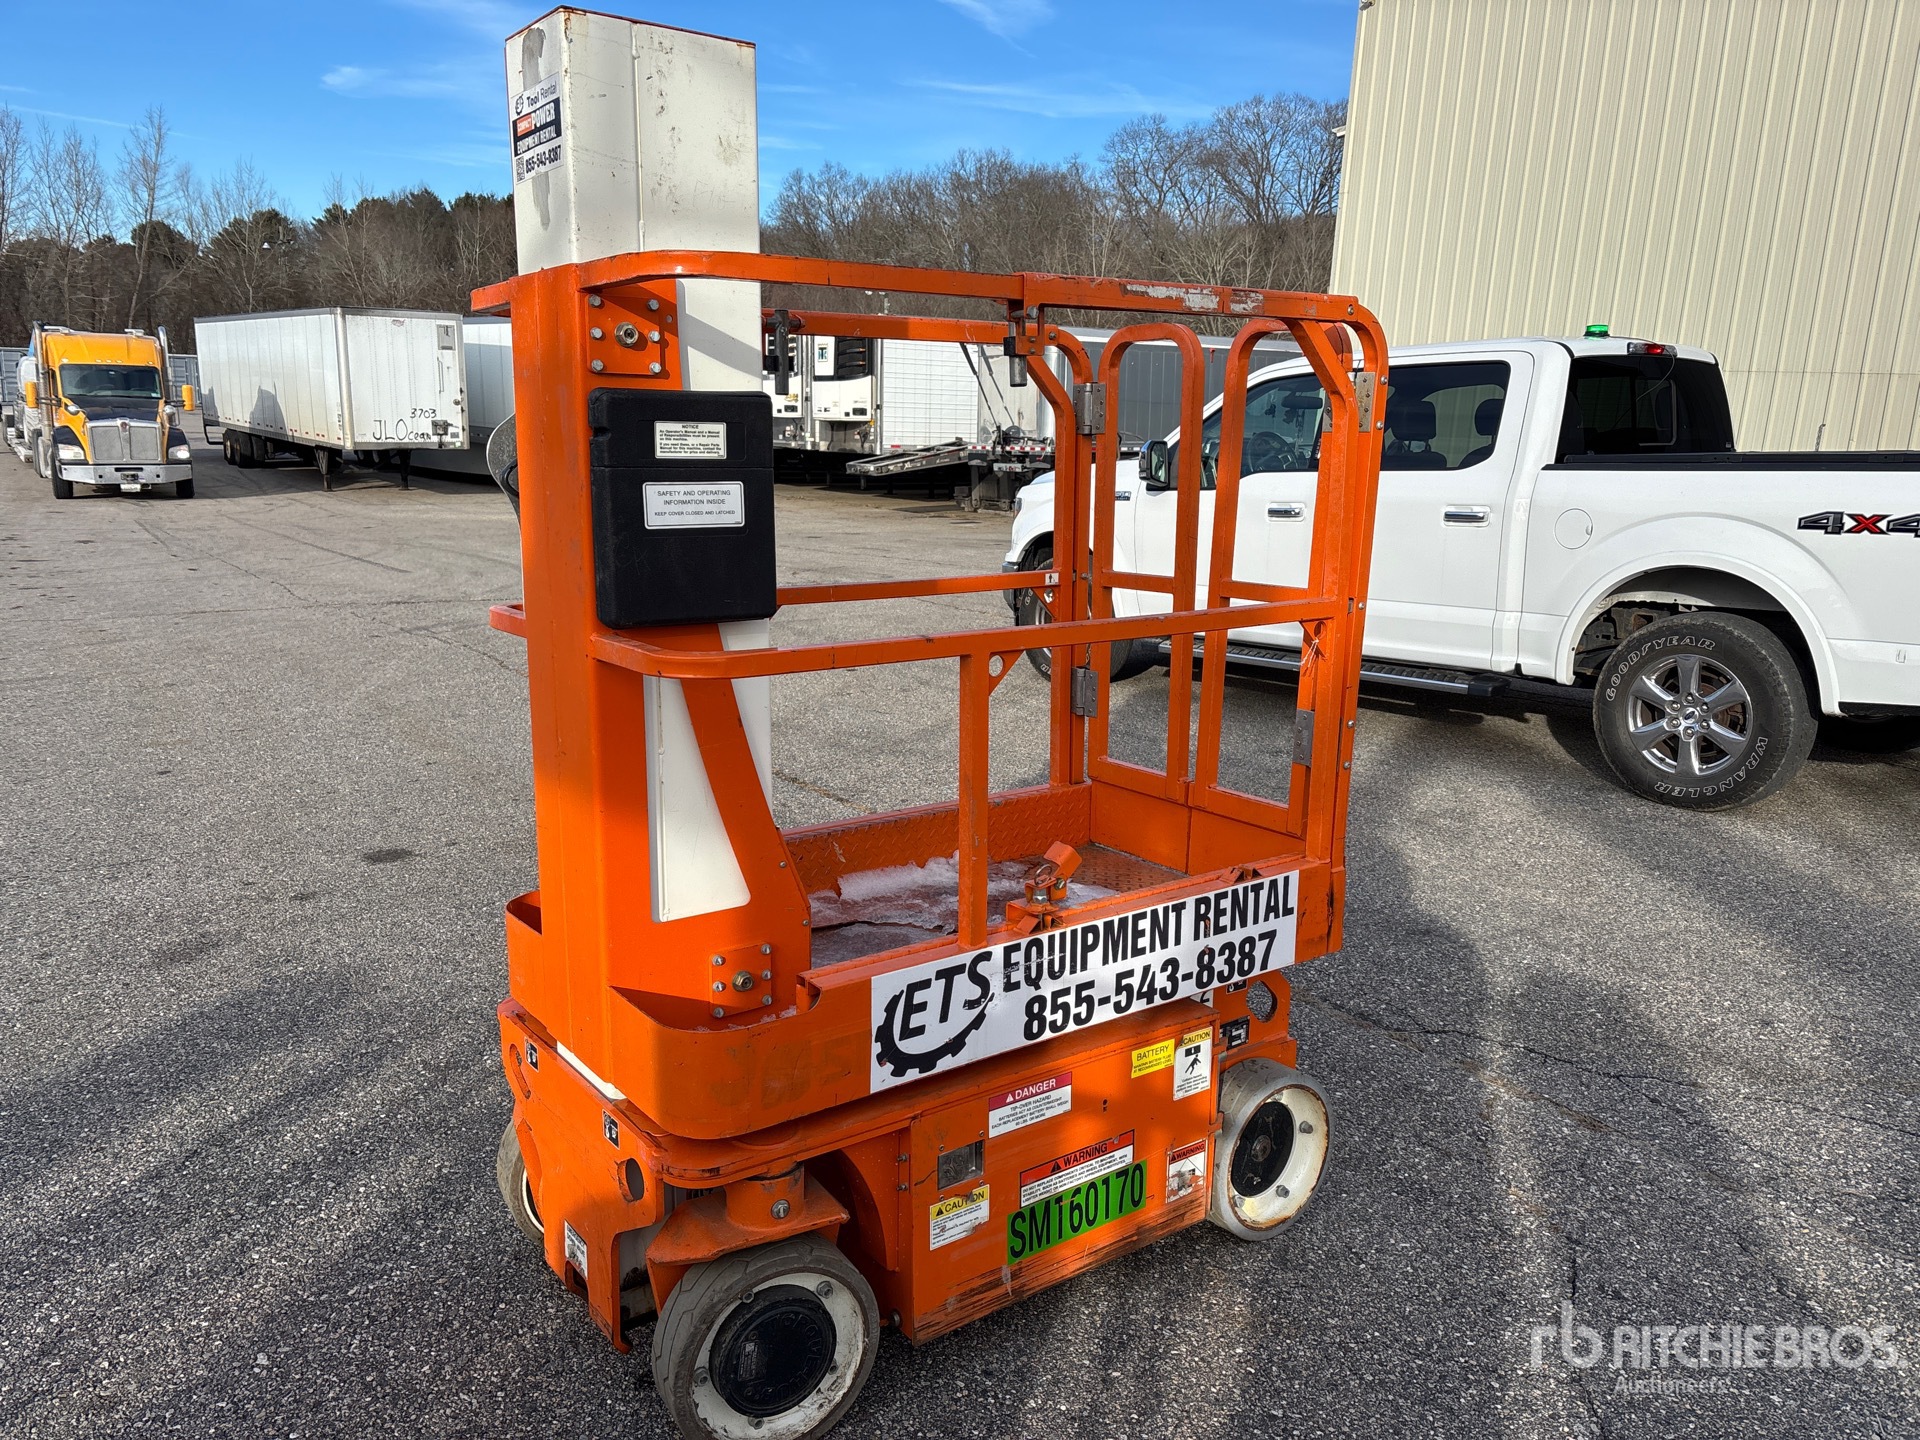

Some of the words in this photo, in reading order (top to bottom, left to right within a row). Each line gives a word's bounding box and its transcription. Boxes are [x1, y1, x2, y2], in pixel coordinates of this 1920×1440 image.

[526, 91, 540, 108] Tool
[540, 80, 557, 99] Rental
[531, 102, 555, 130] POWER
[517, 132, 540, 155] EQUIPMENT
[540, 125, 557, 144] RENTAL
[525, 145, 562, 174] 855-543-8387
[410, 408, 437, 419] 3703
[1605, 635, 1716, 701] GOODYEAR
[1654, 736, 1769, 798] WRANGLER
[1002, 901, 1187, 992] EQUIPMENT
[1193, 875, 1295, 942] RENTAL
[898, 951, 993, 1041] ETS
[1023, 929, 1278, 1041] 855-543-8387
[1183, 1031, 1211, 1045] CAUTION
[1137, 1044, 1170, 1062] BATTERY
[1015, 1078, 1056, 1100] DANGER
[1010, 1101, 1032, 1112] TIP-OVER
[1033, 1095, 1052, 1107] HAZARD
[998, 1111, 1018, 1122] BATTERIES
[1002, 1114, 1029, 1126] REPLACEMENT
[1029, 1108, 1045, 1117] BATTERY
[1063, 1142, 1108, 1167] WARNING
[1176, 1143, 1205, 1159] WARNING
[1037, 1178, 1053, 1188] REPLACE
[1053, 1168, 1078, 1180] COMPONENTS
[944, 1190, 985, 1213] CAUTON
